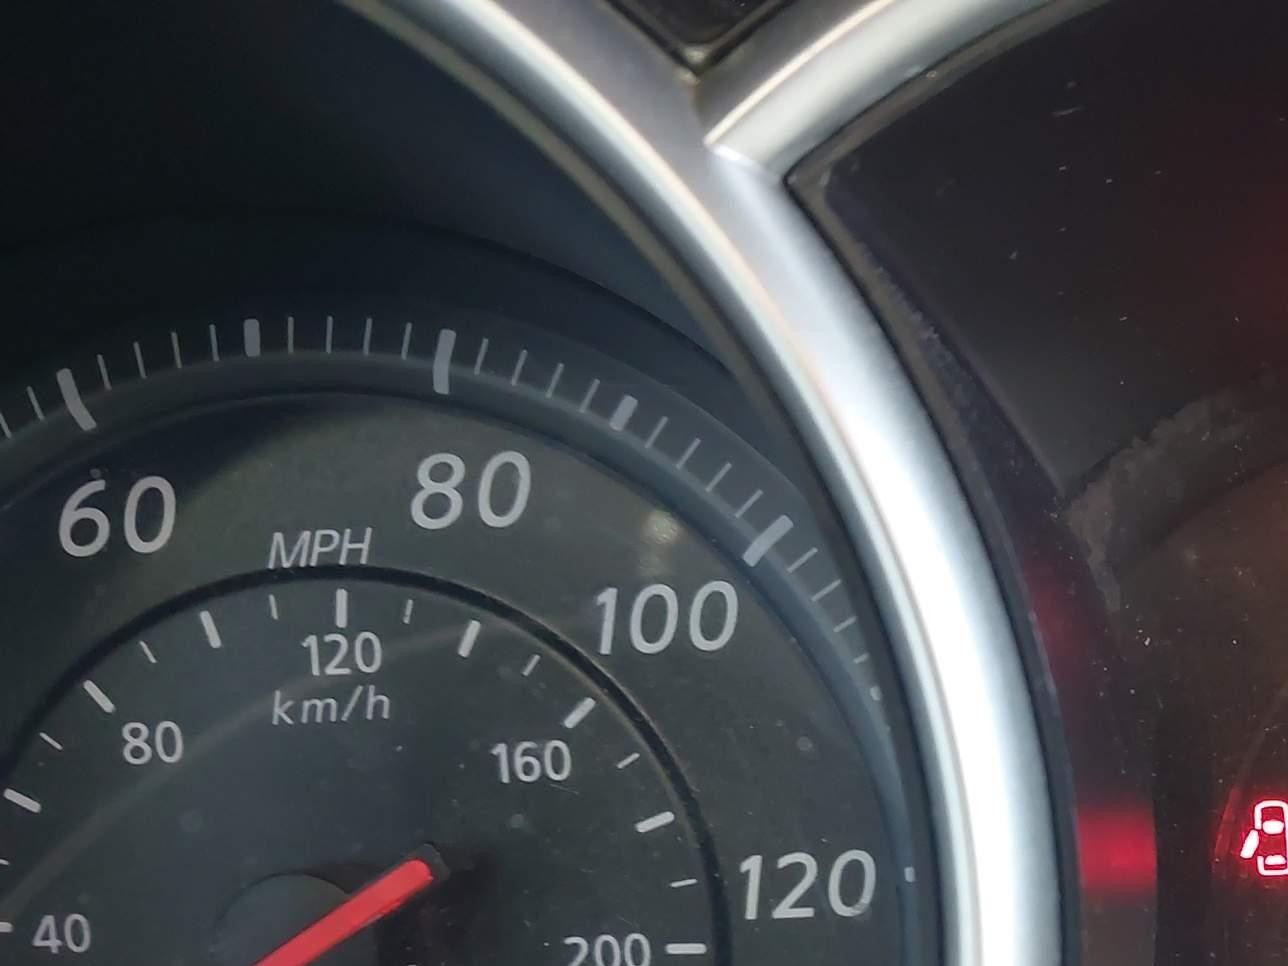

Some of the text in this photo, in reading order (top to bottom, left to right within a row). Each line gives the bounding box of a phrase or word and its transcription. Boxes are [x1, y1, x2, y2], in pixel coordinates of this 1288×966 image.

[411, 450, 531, 530] 80
[58, 475, 176, 557] 60
[268, 527, 373, 568] MPH
[594, 580, 739, 656] 100
[300, 632, 382, 676] 120
[271, 689, 390, 726] km/h
[122, 721, 184, 764] 80
[491, 739, 572, 783] 160
[739, 850, 877, 919] 120
[33, 913, 91, 953] 40
